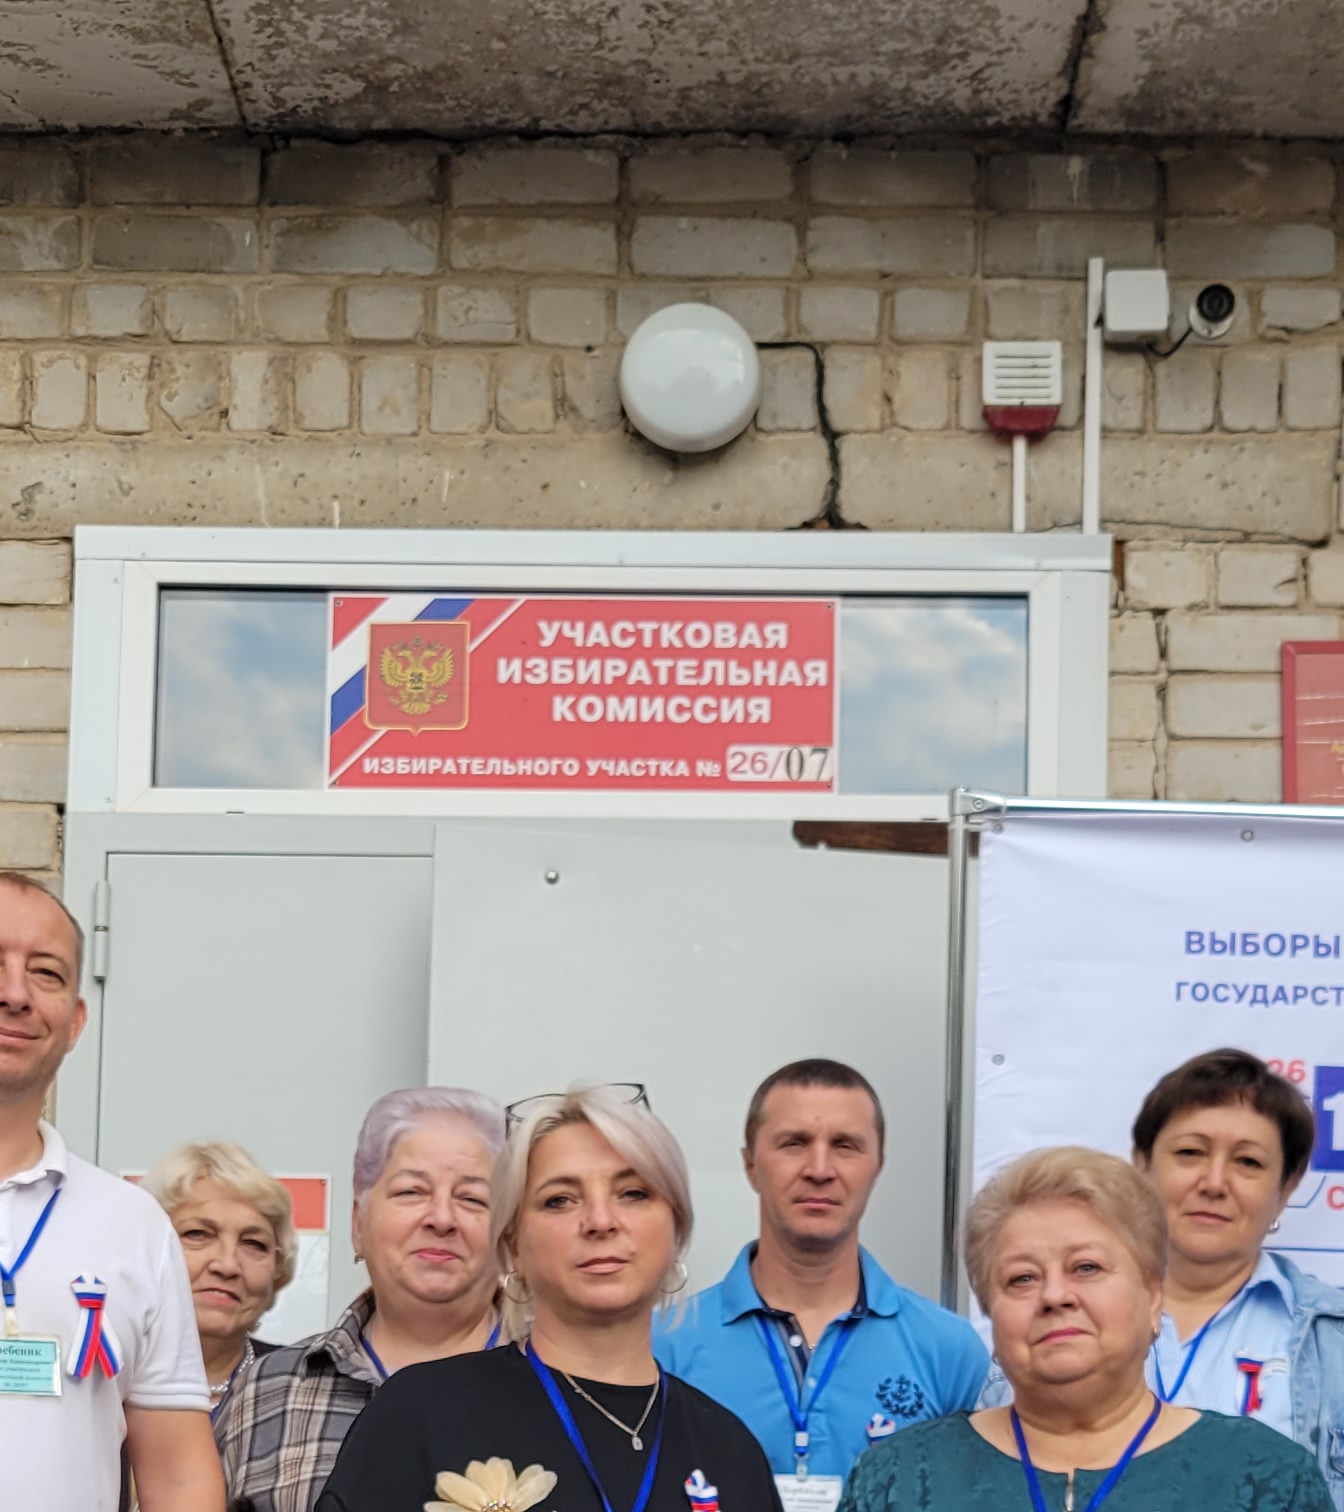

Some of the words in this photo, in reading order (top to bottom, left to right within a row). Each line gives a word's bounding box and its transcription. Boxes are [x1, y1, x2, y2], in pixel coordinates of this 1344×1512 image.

[537, 620, 788, 649] УЧАСТКОВАЯ
[497, 658, 828, 687] ИЗБИРАТЕЛЬНАЯ
[552, 694, 772, 724] КОМИССИЯ
[362, 756, 580, 776] ИЗБИРАТЕЛЬНОГО
[586, 758, 690, 777] УЧАСТКА
[696, 760, 722, 777] №
[729, 746, 831, 782] 26/07
[1184, 930, 1340, 959] ВЫБОРЫ
